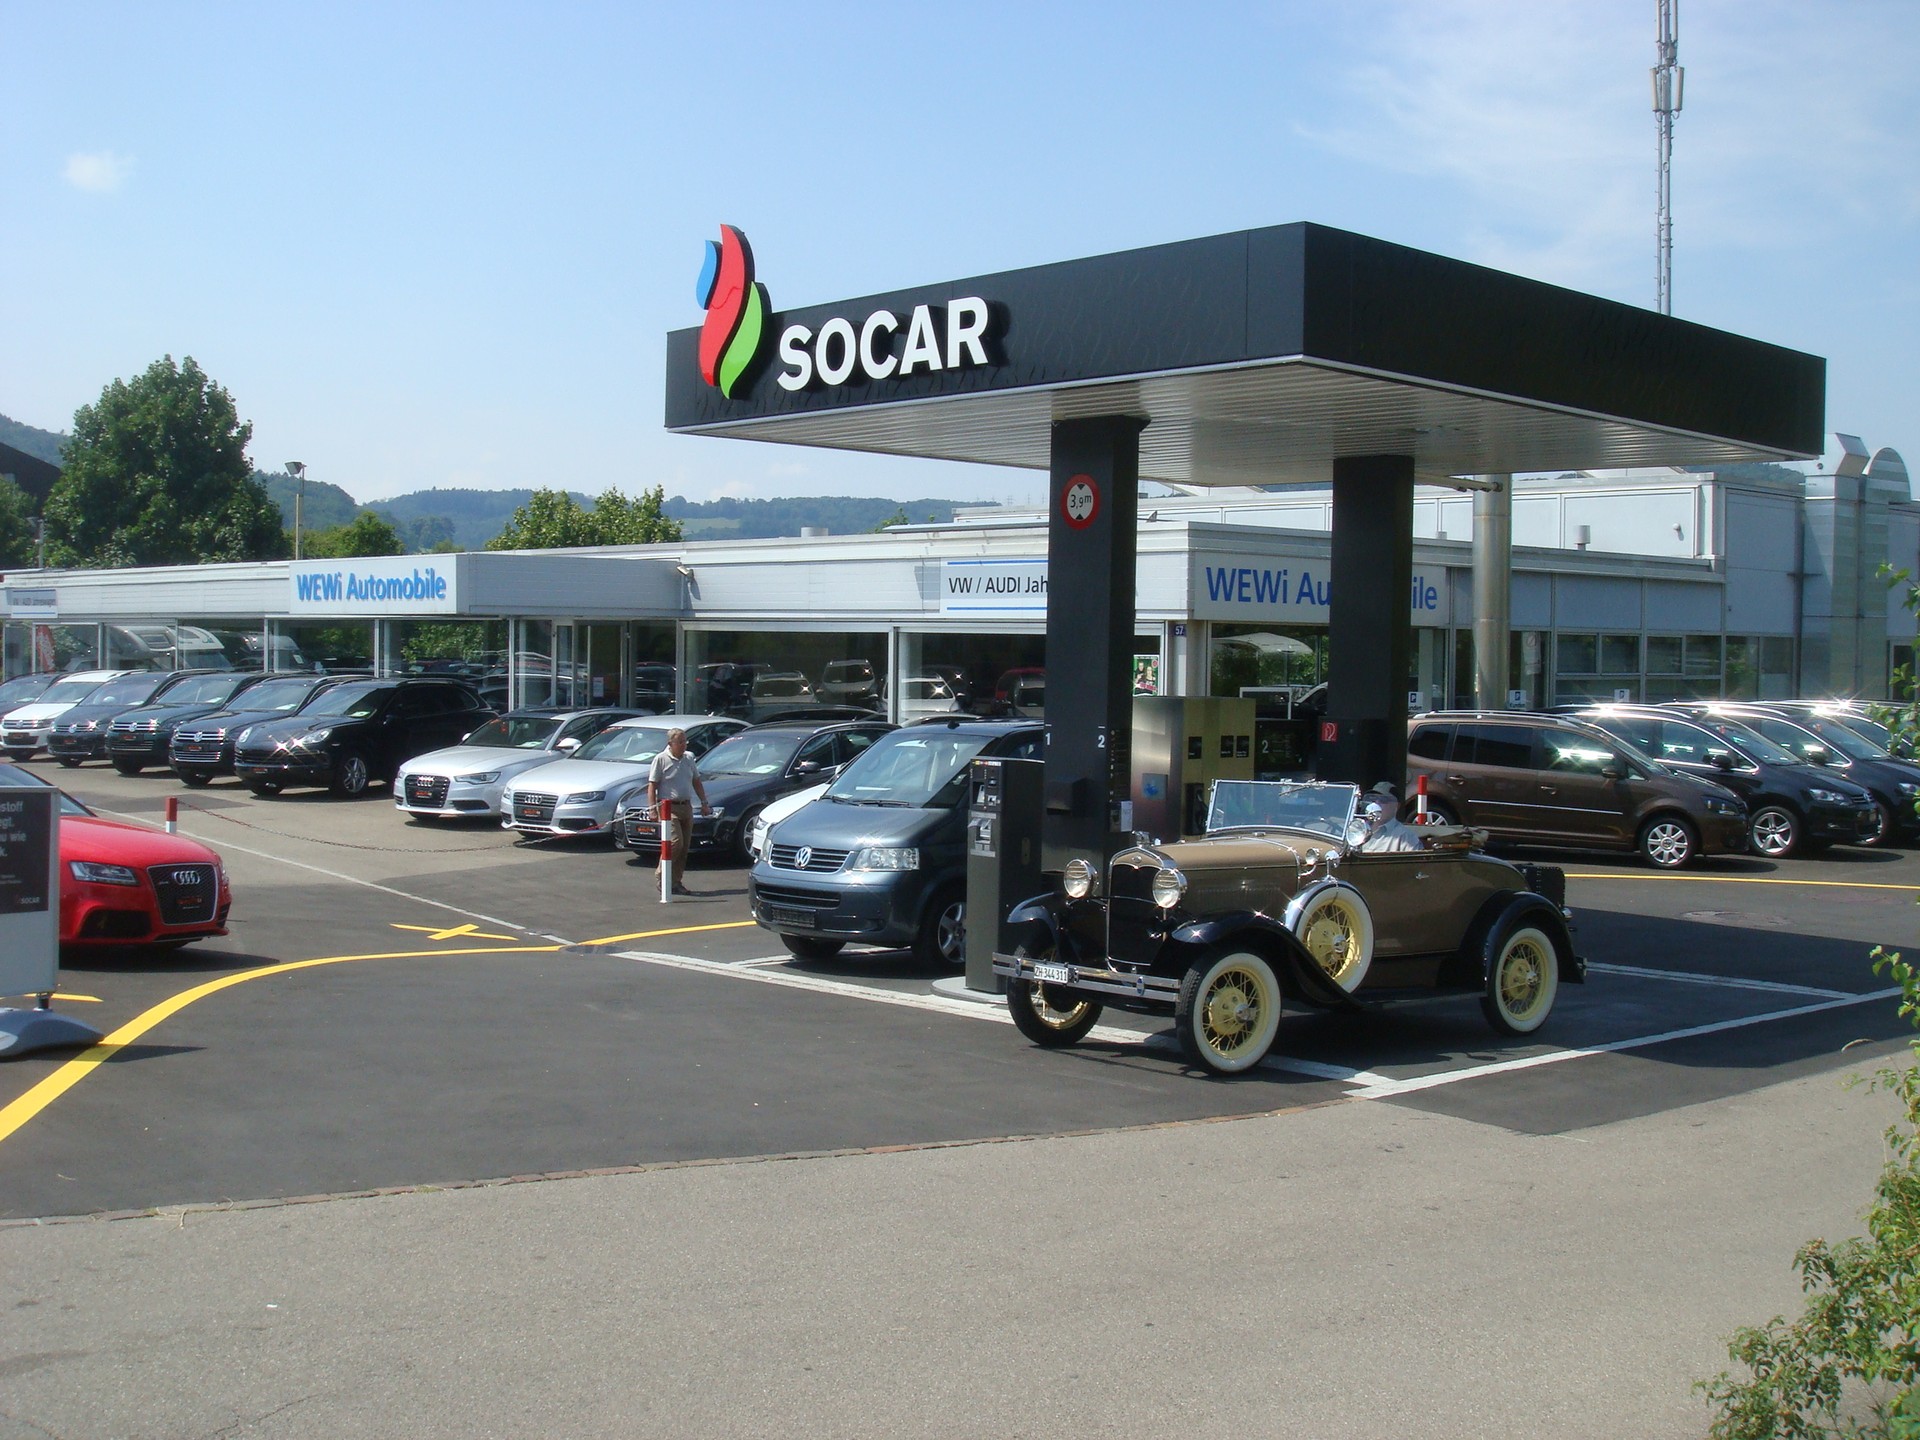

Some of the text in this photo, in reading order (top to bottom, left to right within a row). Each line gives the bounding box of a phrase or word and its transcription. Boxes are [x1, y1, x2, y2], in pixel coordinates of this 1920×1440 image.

[776, 296, 989, 392] SOCAR
[296, 567, 447, 602] WEWi Automobile
[948, 576, 973, 594] VW
[985, 576, 1021, 594] AUDI
[1205, 566, 1438, 610] WEWi Auile
[1175, 625, 1184, 635] 57
[1045, 732, 1051, 746] 1
[1097, 734, 1105, 748] 2
[1261, 739, 1269, 753] 2
[21, 896, 40, 904] SOCAR
